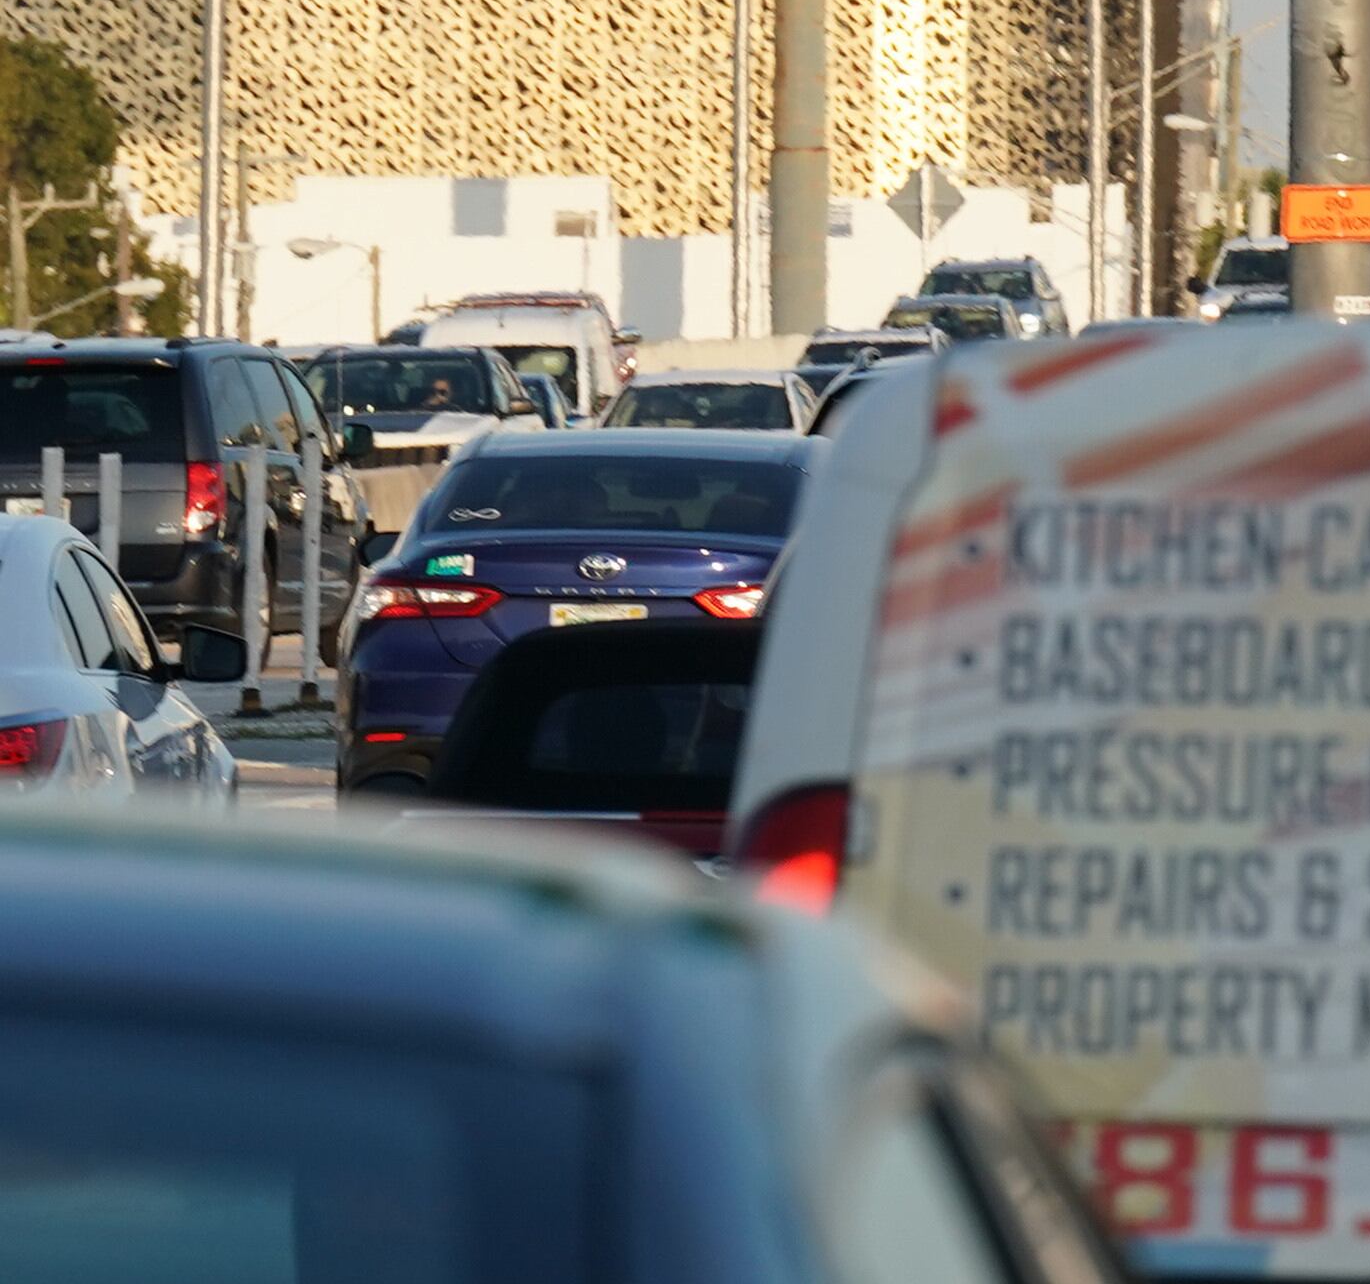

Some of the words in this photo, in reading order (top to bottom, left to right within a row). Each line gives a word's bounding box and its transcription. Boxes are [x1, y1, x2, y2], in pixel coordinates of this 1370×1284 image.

[993, 728, 1345, 825] PRESSURE
[984, 845, 1273, 942] REPAIRS
[979, 962, 1332, 1062] PROPERTY
